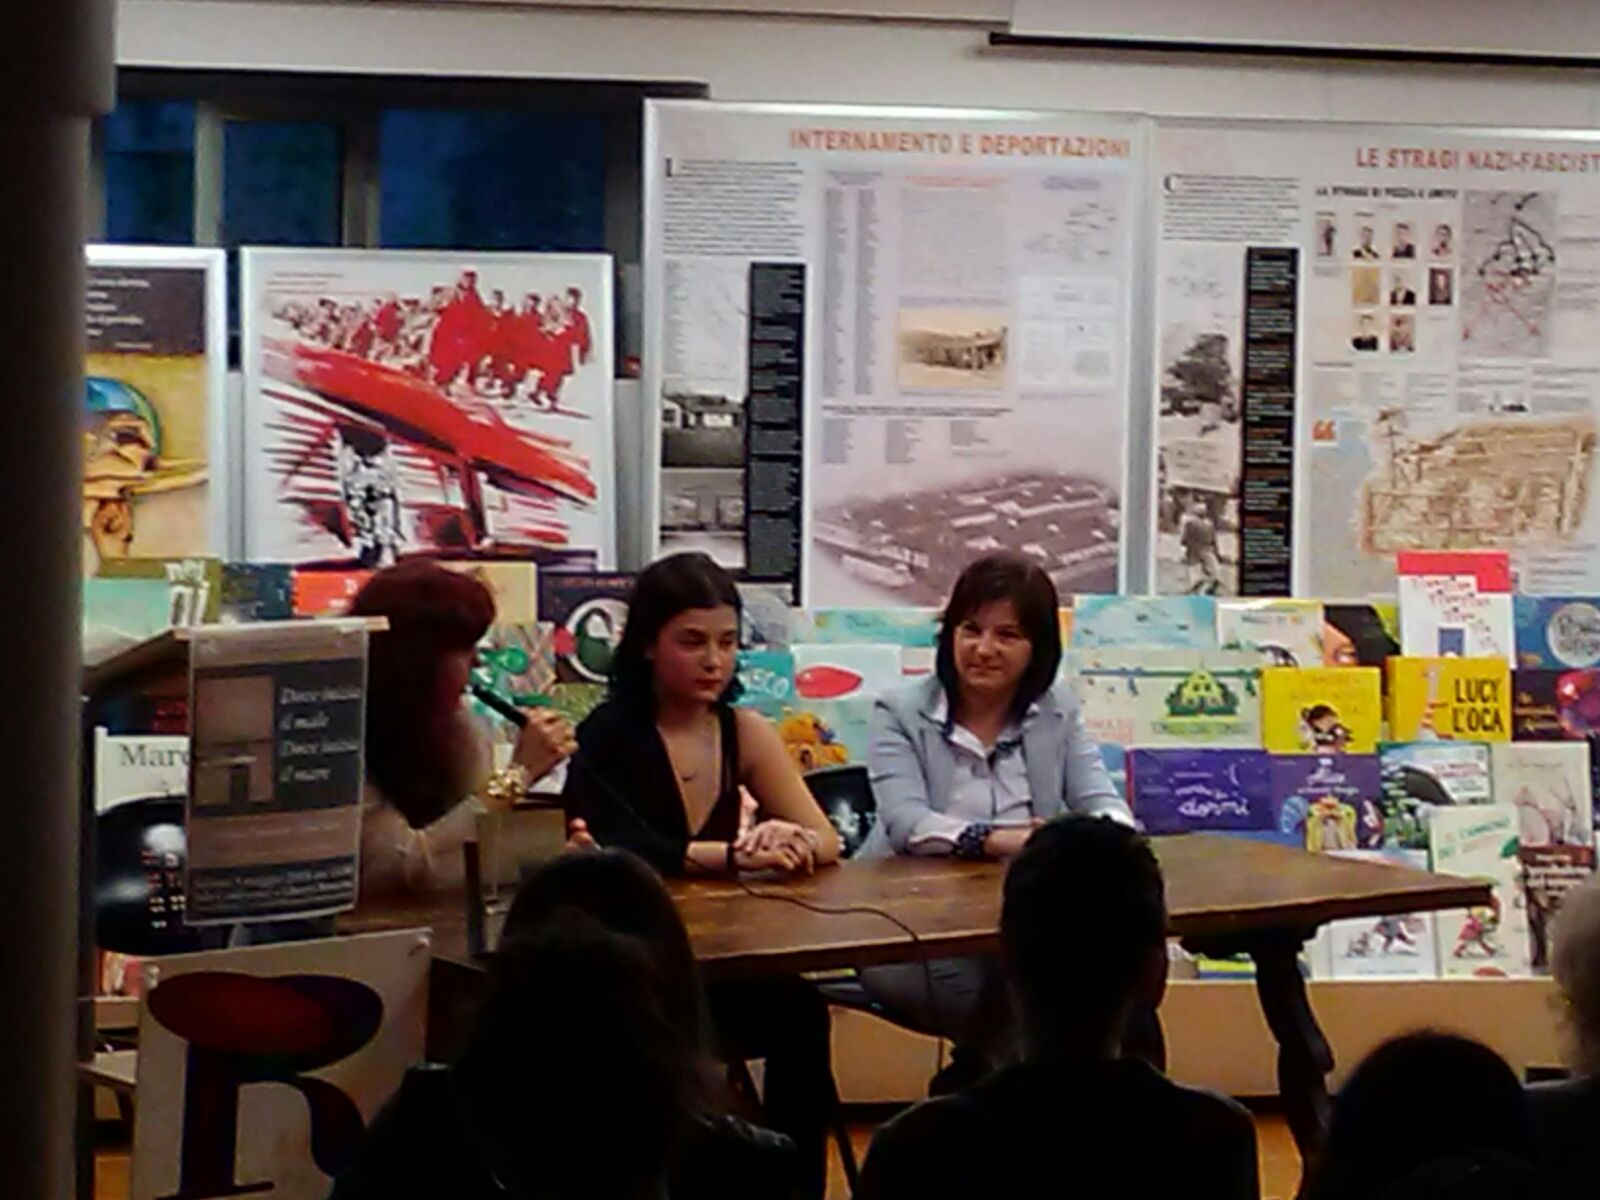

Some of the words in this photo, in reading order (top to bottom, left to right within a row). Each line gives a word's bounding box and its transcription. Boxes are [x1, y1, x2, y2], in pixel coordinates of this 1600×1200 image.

[789, 128, 951, 153] INTERNAMENTO
[961, 133, 973, 154] E
[979, 133, 1130, 158] DEPORTAZIONI
[1356, 147, 1379, 168] LE
[1387, 148, 1459, 170] STRAGI
[1455, 678, 1502, 703] LUCY
[1453, 707, 1504, 733] L'OCA
